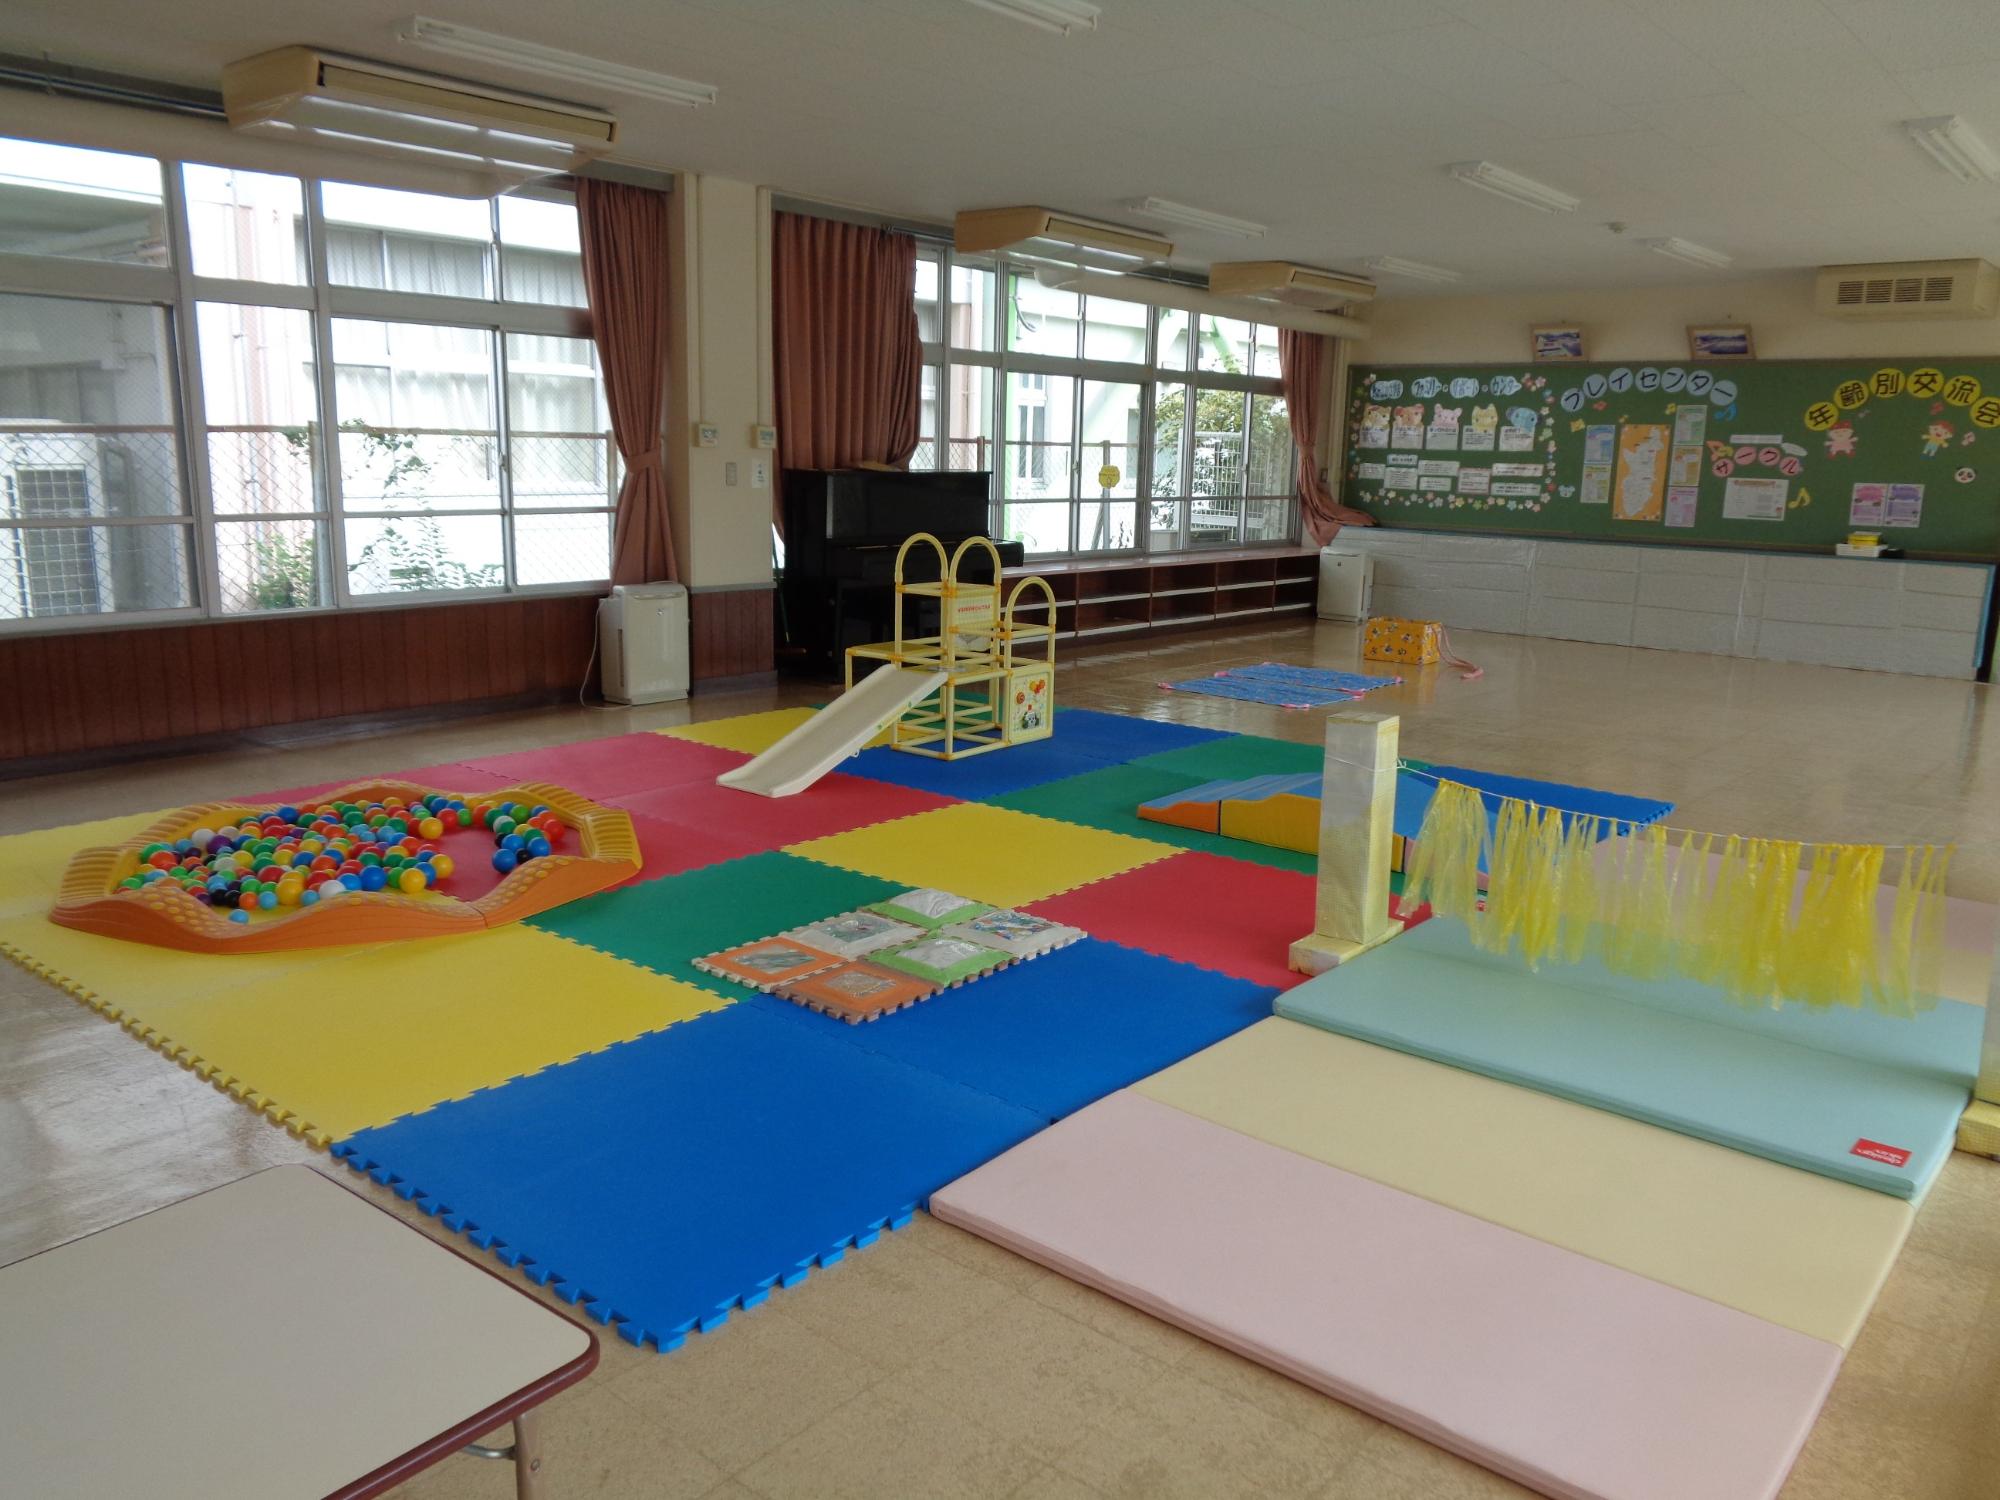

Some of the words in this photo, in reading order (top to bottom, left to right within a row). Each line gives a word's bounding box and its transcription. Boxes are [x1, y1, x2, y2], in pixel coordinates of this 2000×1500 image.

[1565, 372, 1733, 409] プレイセンター
[1808, 372, 2000, 427] 年齢別交流会
[1715, 449, 1796, 475] サークル
